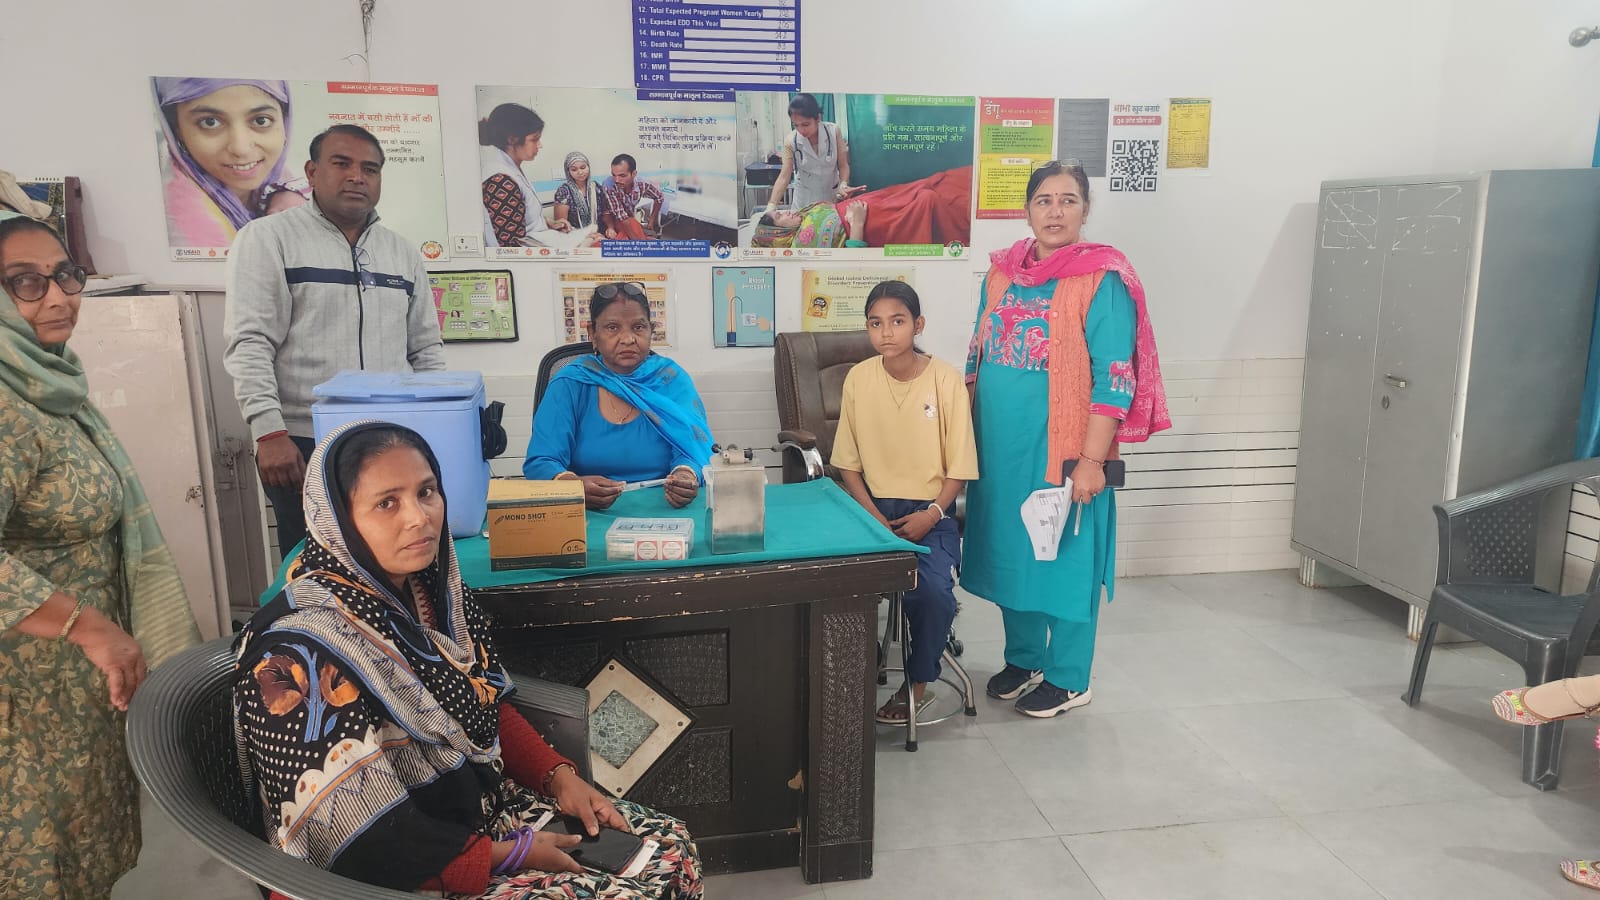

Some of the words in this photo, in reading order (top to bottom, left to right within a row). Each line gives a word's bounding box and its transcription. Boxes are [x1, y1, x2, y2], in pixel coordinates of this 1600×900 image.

[693, 8, 720, 16] Pregnant
[744, 10, 762, 18] Yearly
[385, 113, 401, 122] होती
[422, 114, 432, 122] की
[899, 123, 915, 131] करते
[937, 124, 958, 132] महिला
[682, 142, 705, 151] अनुमति
